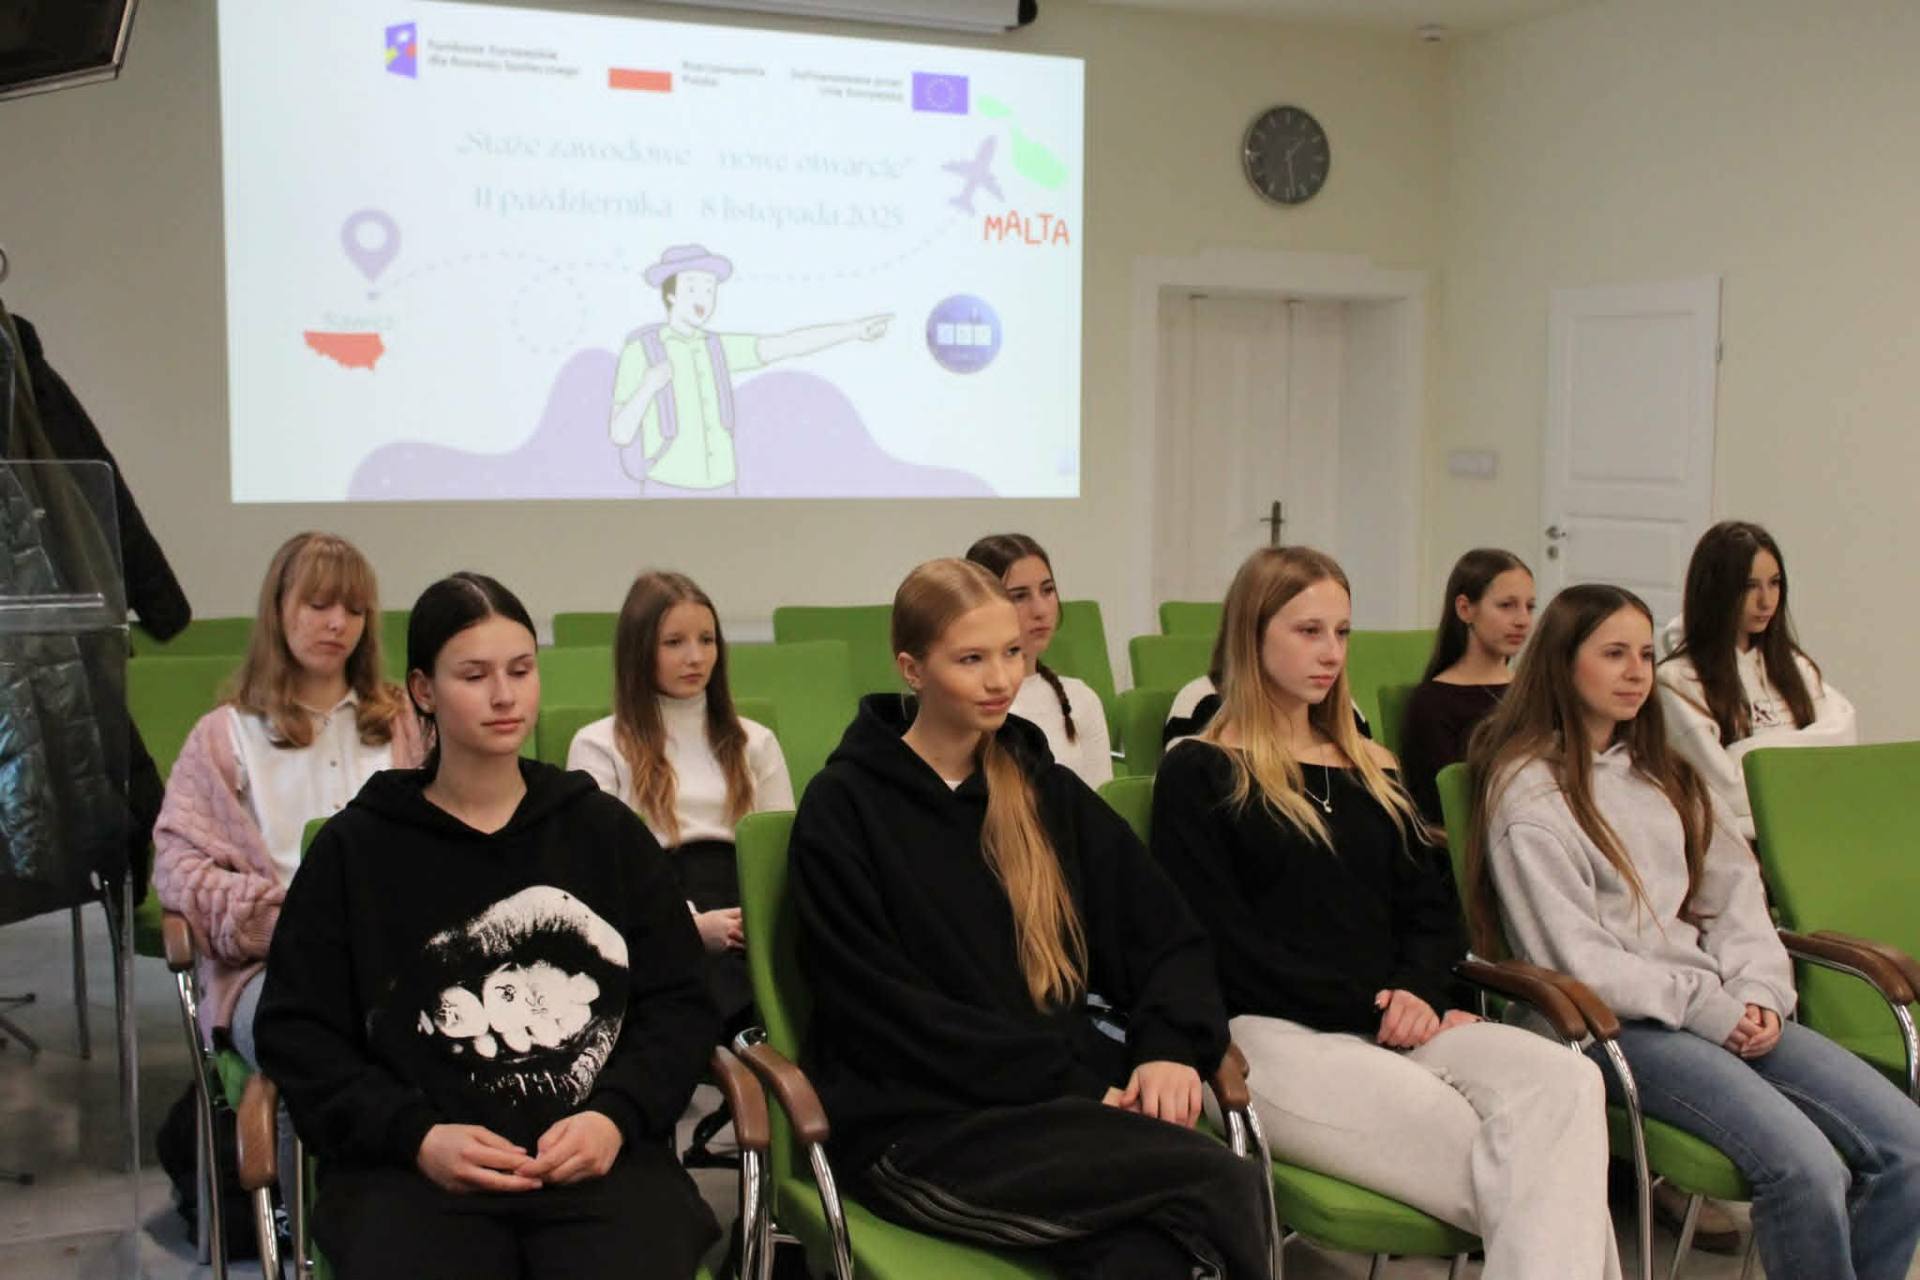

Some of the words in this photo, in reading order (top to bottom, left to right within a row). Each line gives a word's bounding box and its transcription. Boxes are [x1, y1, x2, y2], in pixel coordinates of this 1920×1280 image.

[720, 149, 787, 172] nowe
[722, 194, 840, 230] listopada
[983, 209, 1069, 246] MALTA
